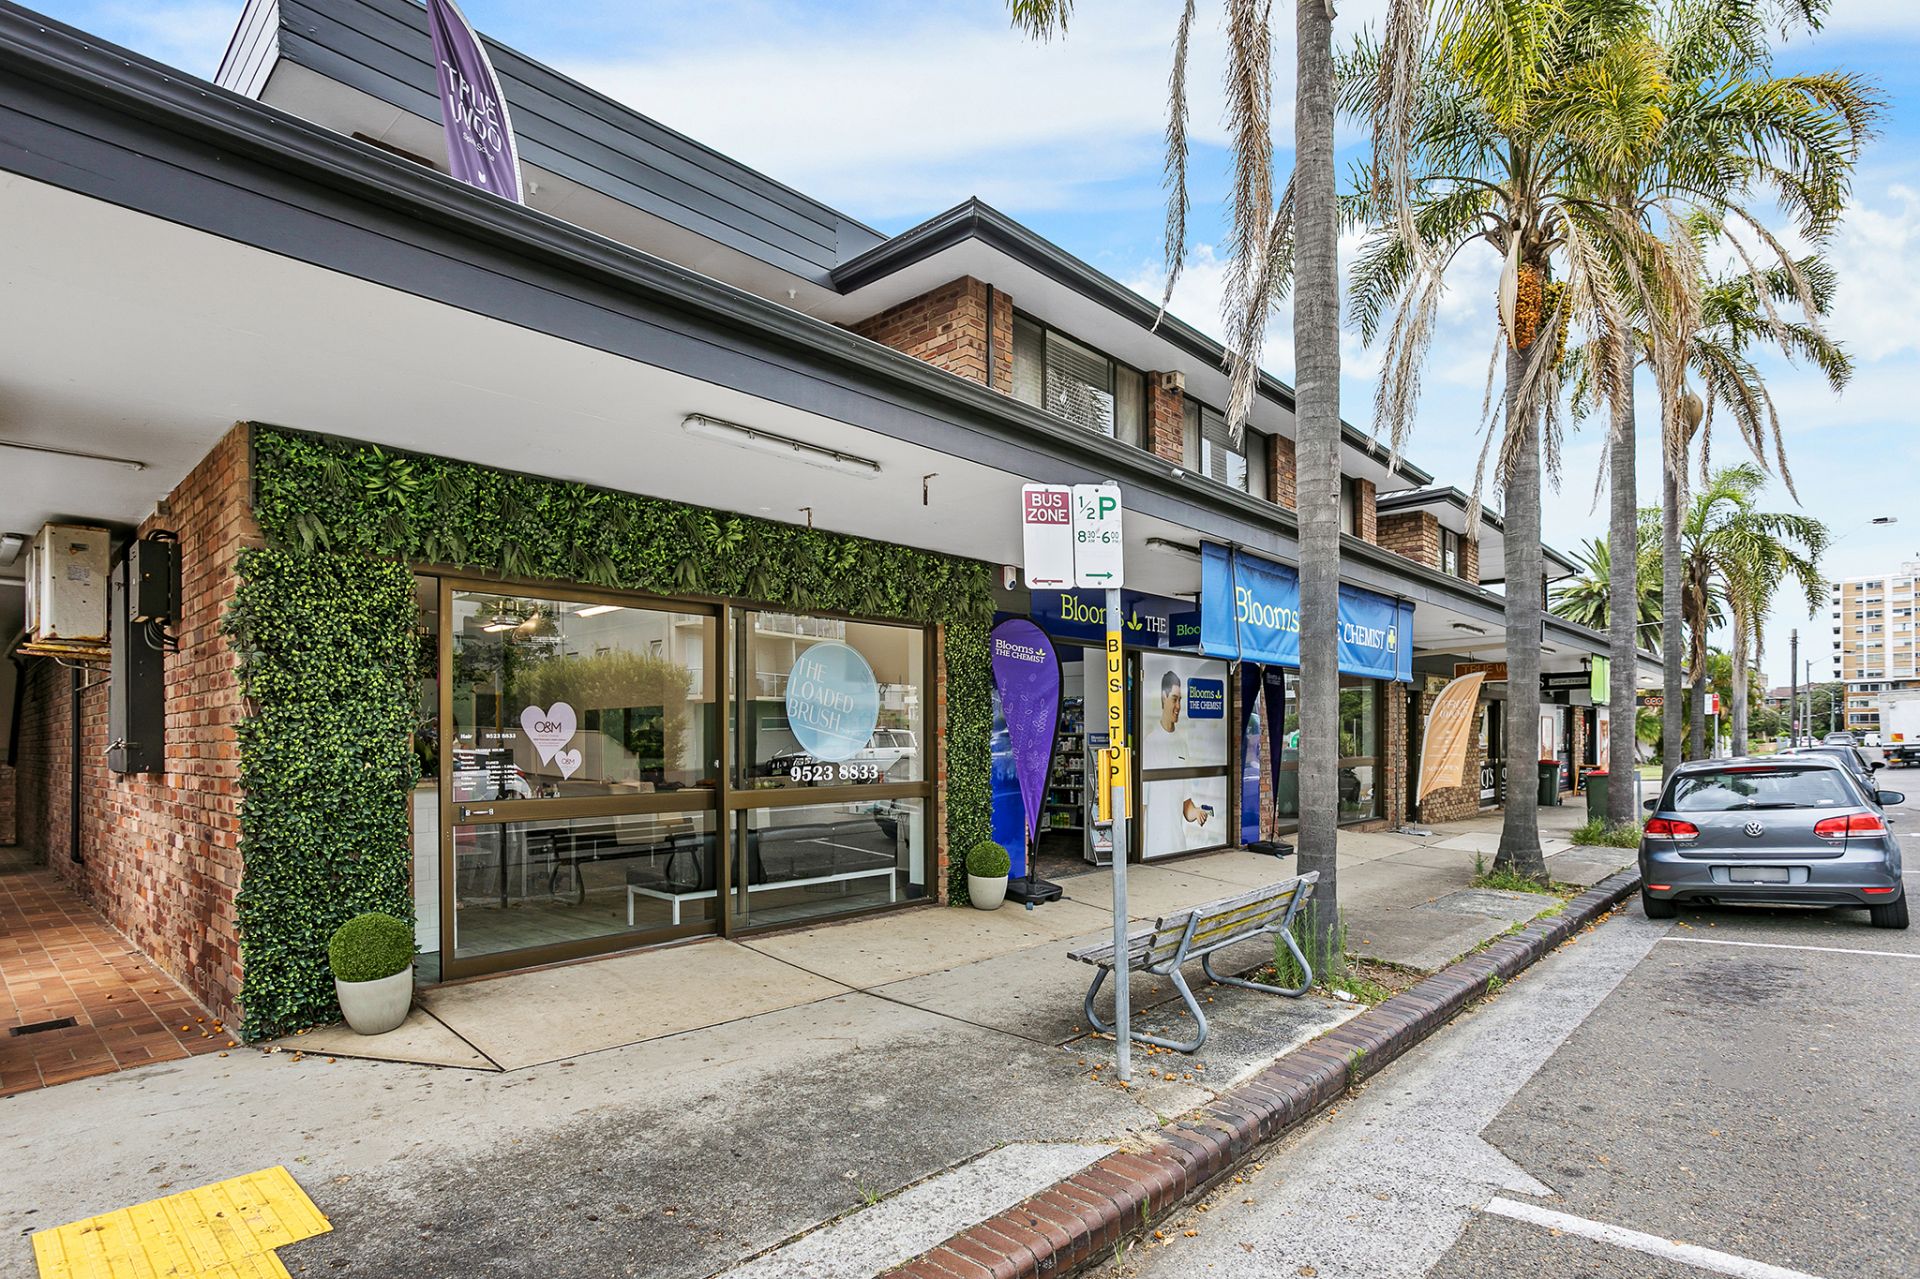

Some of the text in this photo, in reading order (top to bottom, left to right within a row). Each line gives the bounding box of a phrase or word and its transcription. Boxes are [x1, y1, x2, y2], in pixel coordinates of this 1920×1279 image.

[1031, 493, 1062, 507] BUS
[1027, 508, 1068, 522] ZONE
[1145, 615, 1167, 634] THE
[1234, 586, 1300, 633] Blooms
[1343, 622, 1386, 650] CHEMIST
[995, 638, 1034, 655] Blooms
[995, 648, 1046, 664] THE CHEMIST
[799, 656, 828, 684] THE
[791, 676, 855, 715] LOADED
[1189, 686, 1215, 700] Blooms
[1108, 639, 1121, 779] BUS STOP
[1189, 700, 1222, 711] THE CHEMIST
[787, 698, 841, 733] BRUSH
[534, 721, 562, 734] O&M
[789, 763, 879, 782] 9523 8833
